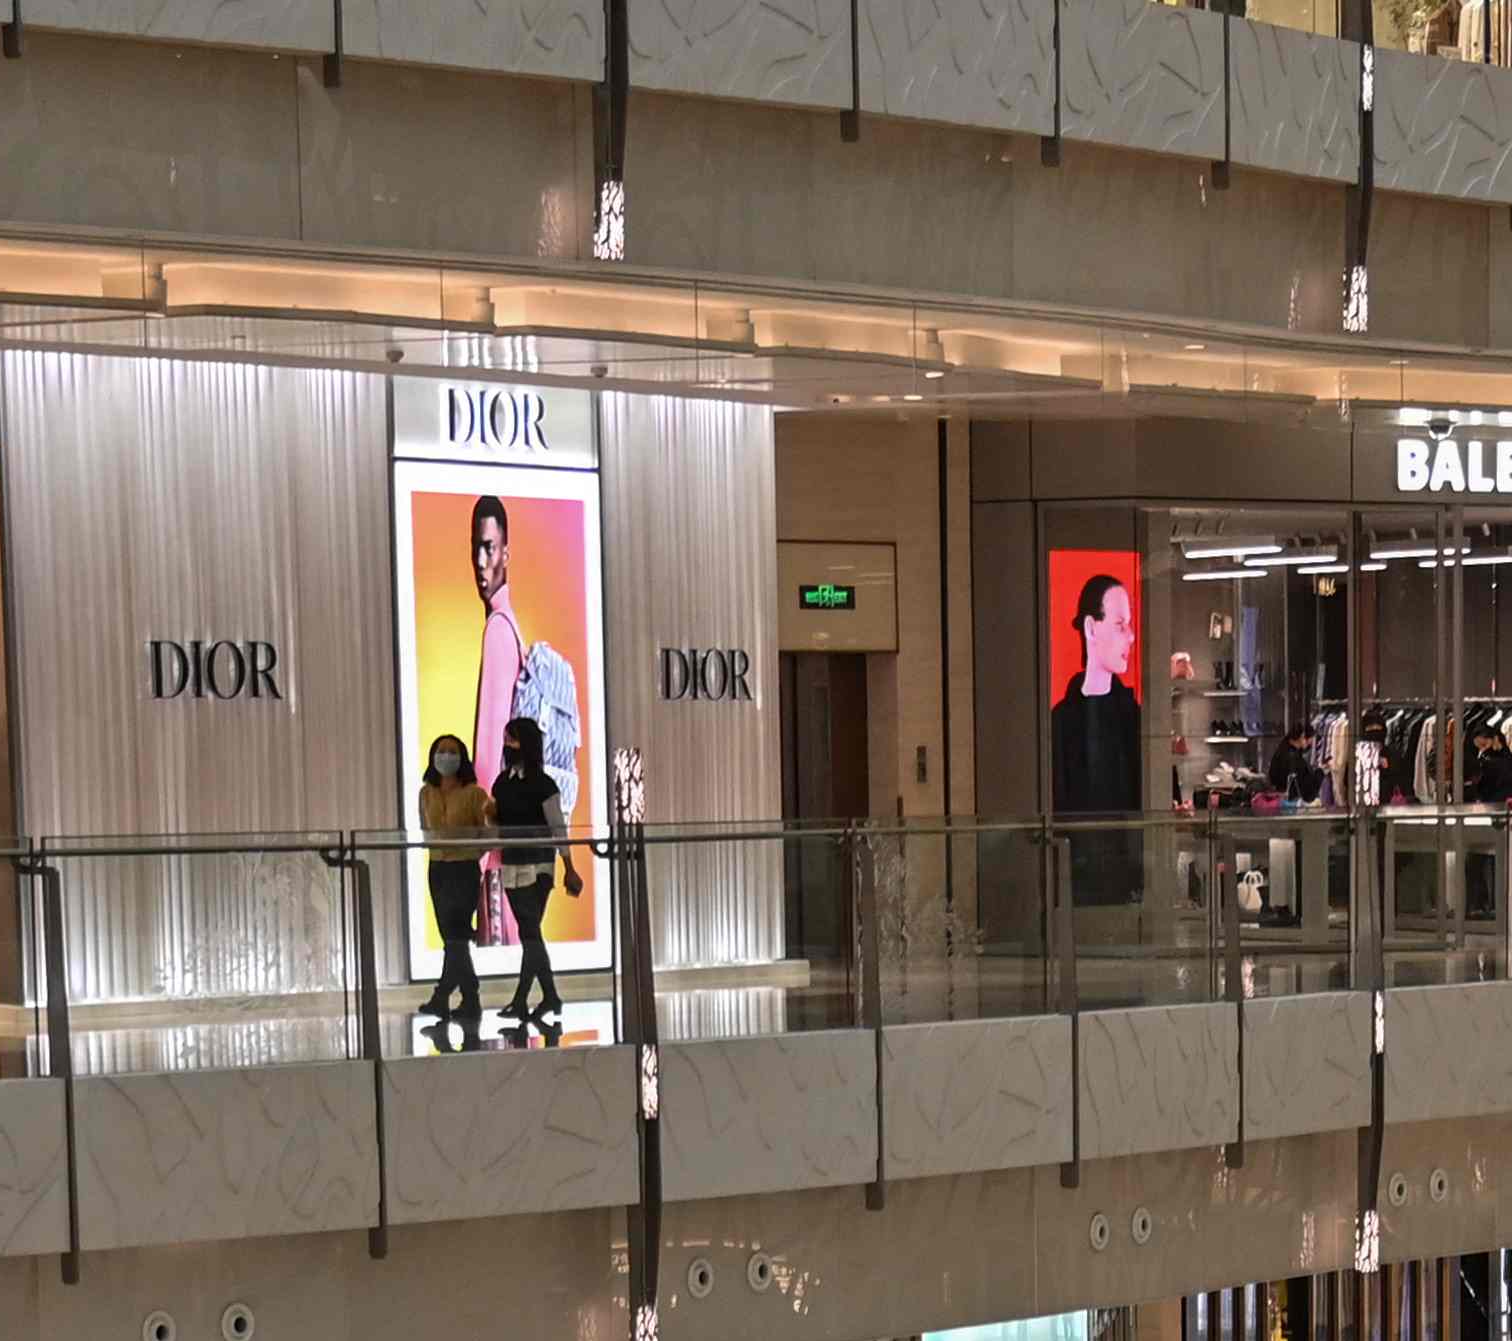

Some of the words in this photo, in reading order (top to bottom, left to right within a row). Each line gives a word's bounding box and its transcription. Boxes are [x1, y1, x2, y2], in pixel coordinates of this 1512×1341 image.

[447, 387, 550, 450] DIOR
[149, 639, 283, 700] DIOR
[660, 646, 754, 702] DIOR
